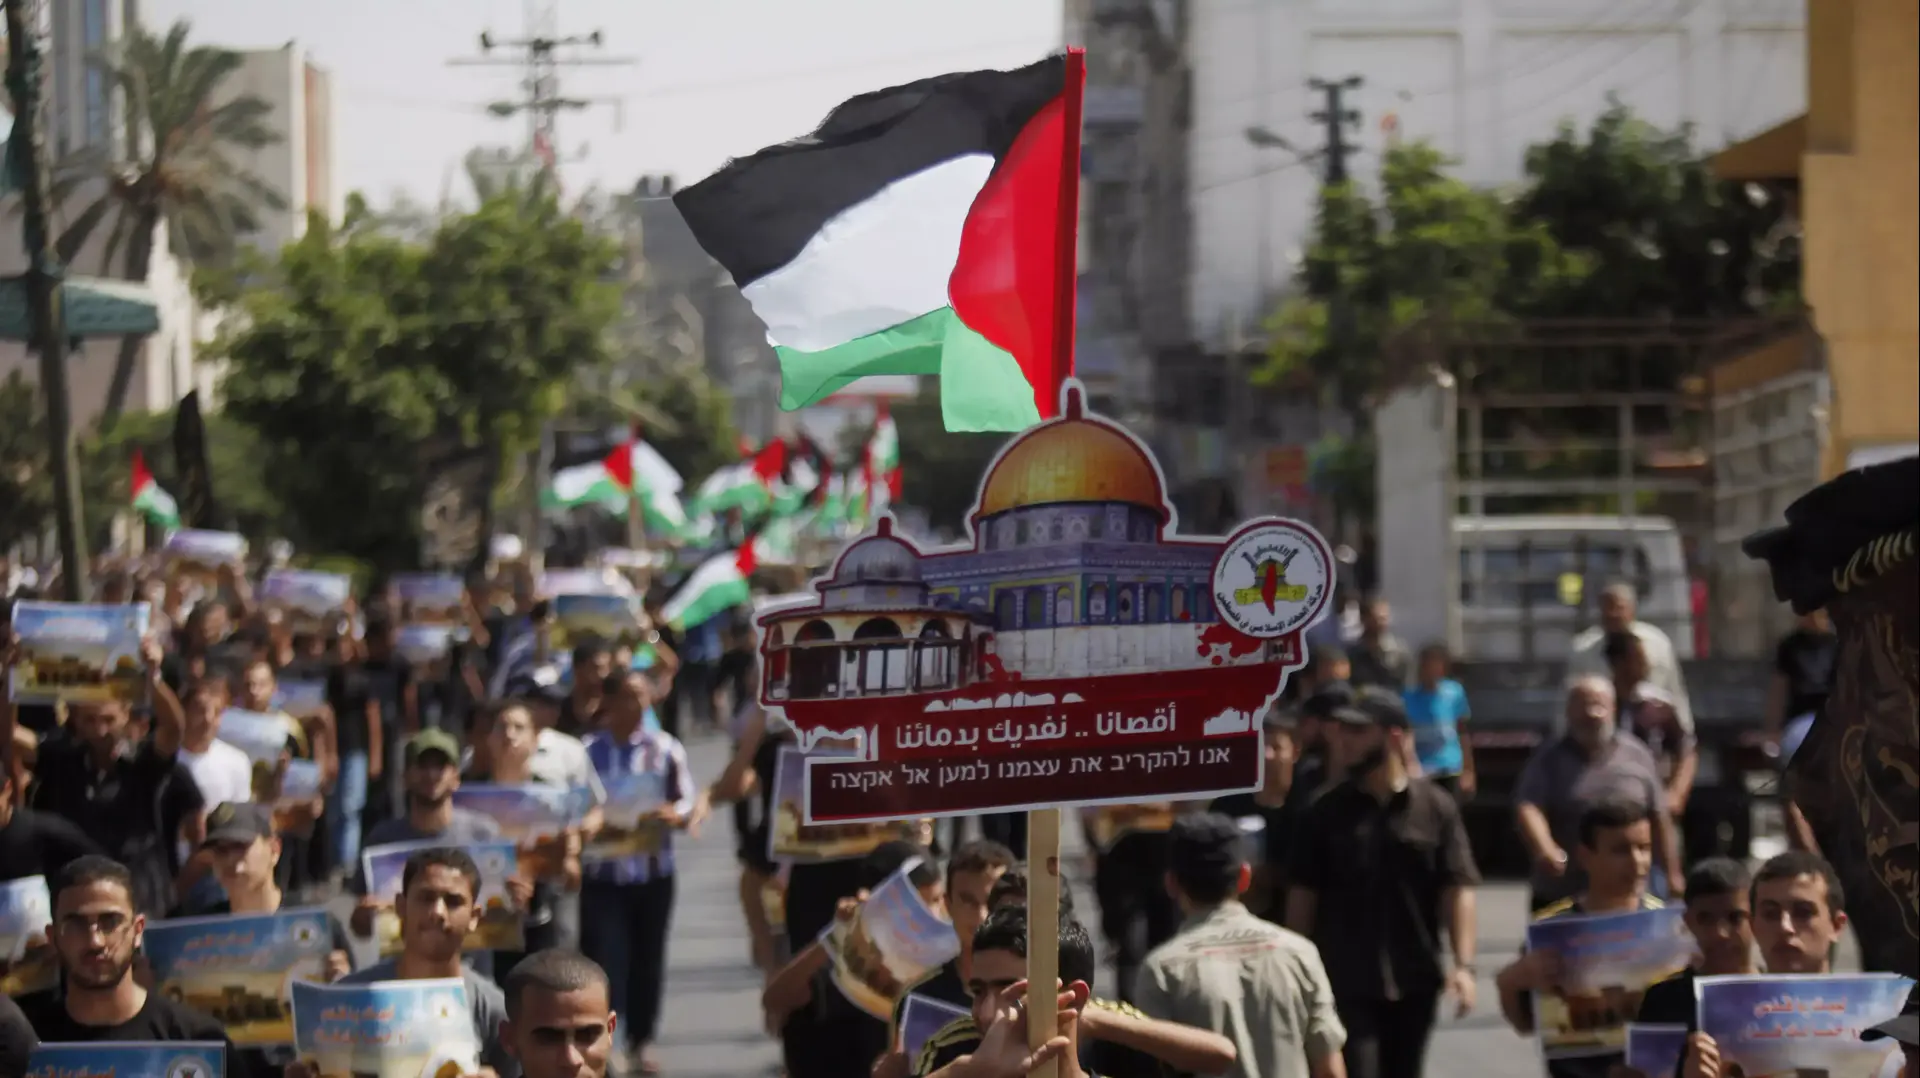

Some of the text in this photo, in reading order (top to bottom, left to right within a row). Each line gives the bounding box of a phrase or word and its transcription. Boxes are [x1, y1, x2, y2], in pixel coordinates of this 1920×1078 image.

[896, 722, 980, 751] بدمائنا
[987, 713, 1067, 749] نفديك
[1096, 702, 1176, 736] أقصانا
[831, 745, 1230, 793] אנו להקריב את עצמנו למען אל אקצה
